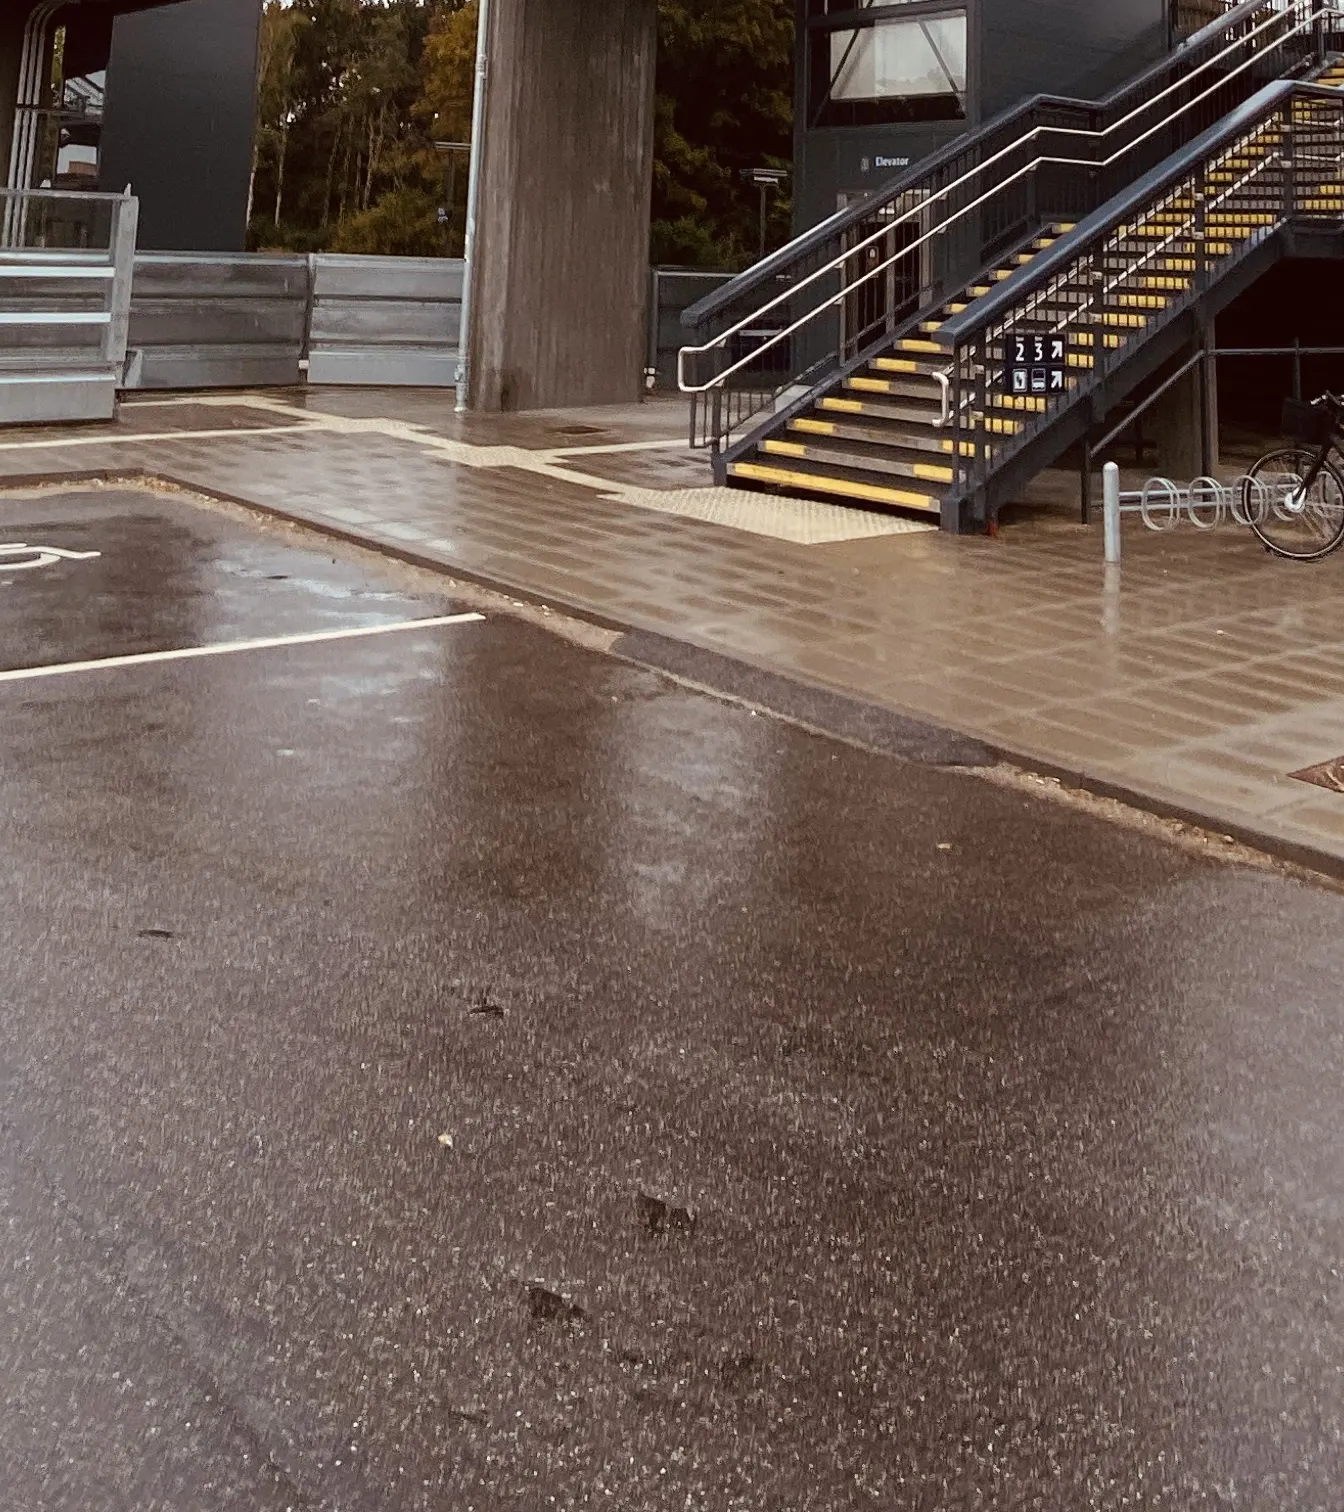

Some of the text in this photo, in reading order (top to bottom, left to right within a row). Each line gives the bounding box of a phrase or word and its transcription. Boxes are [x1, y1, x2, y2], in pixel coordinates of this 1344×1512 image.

[875, 156, 909, 167] Elevator
[1015, 343, 1043, 362] 2 3
